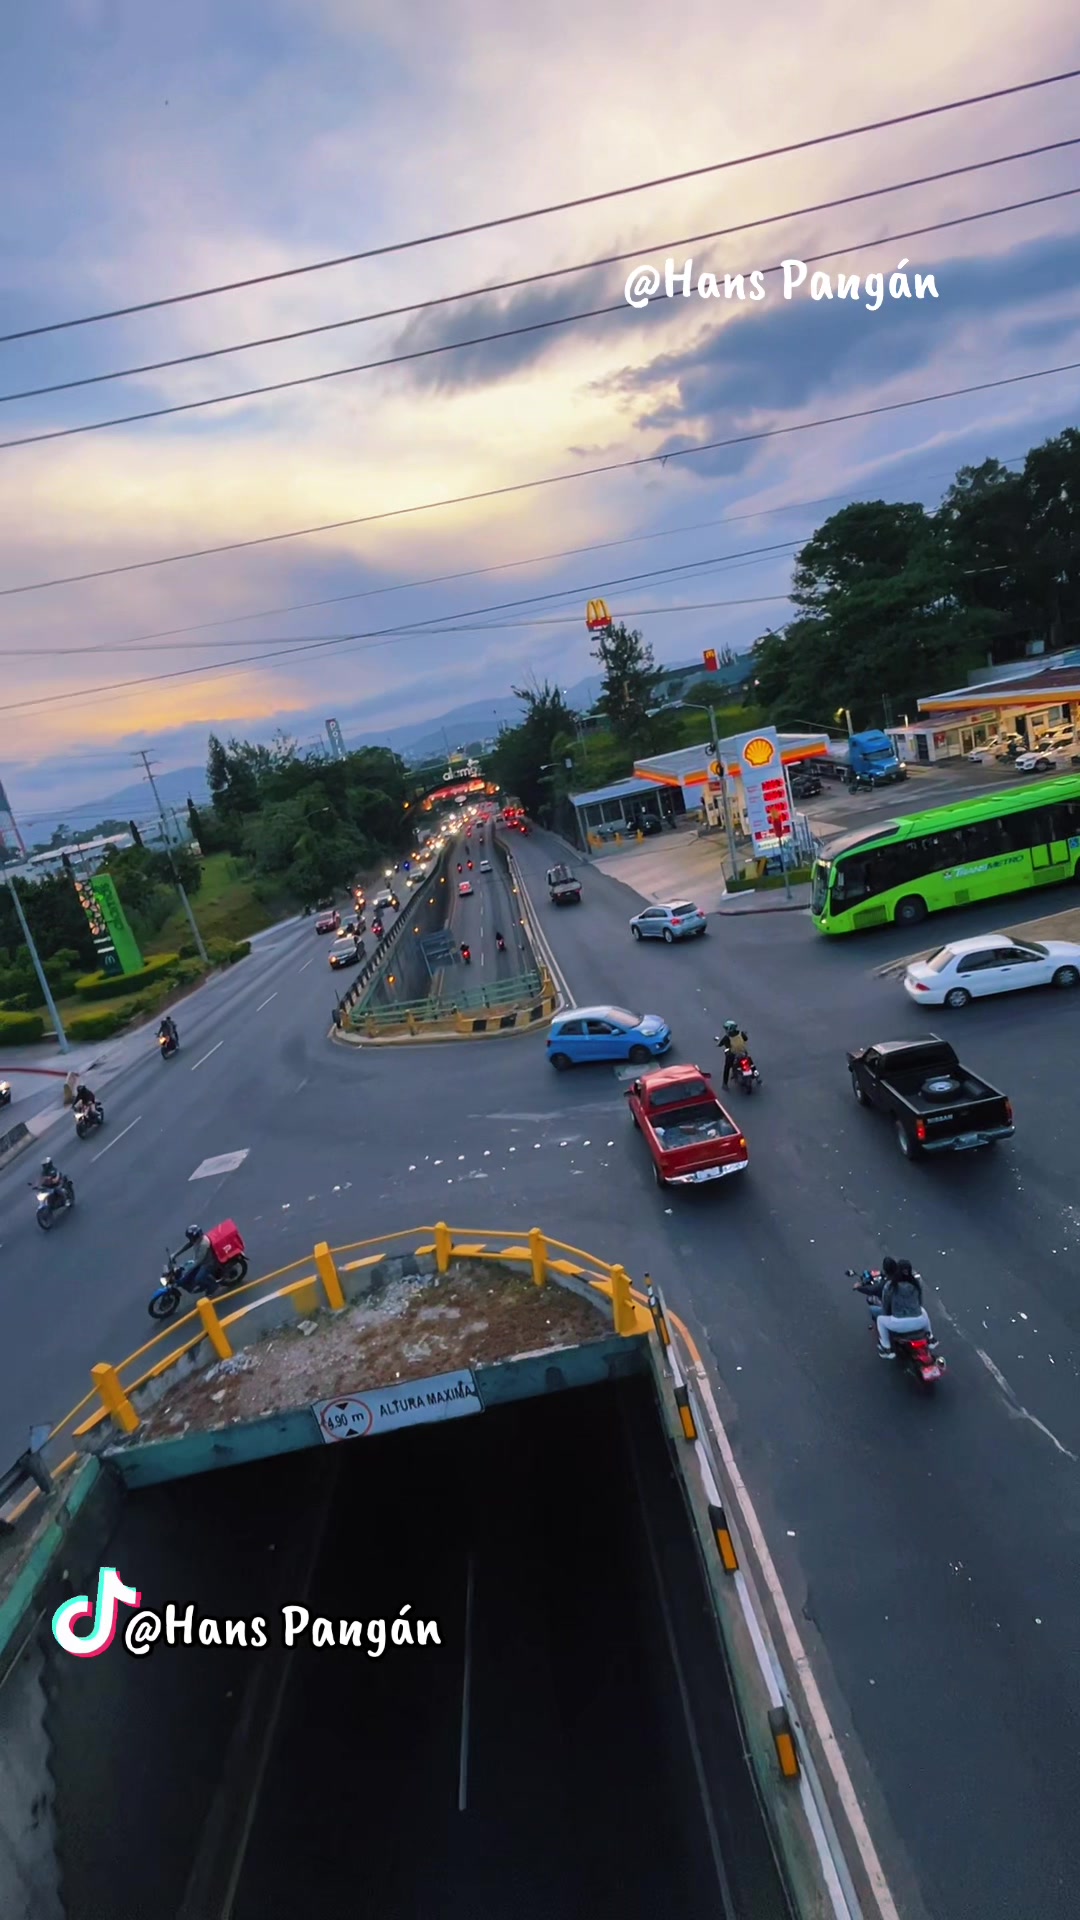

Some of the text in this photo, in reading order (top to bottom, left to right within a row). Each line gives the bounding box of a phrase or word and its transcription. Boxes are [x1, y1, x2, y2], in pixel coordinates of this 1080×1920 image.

[379, 1385, 475, 1417] ALTURA MAXIMA
[327, 1411, 365, 1430] 4.90 m
